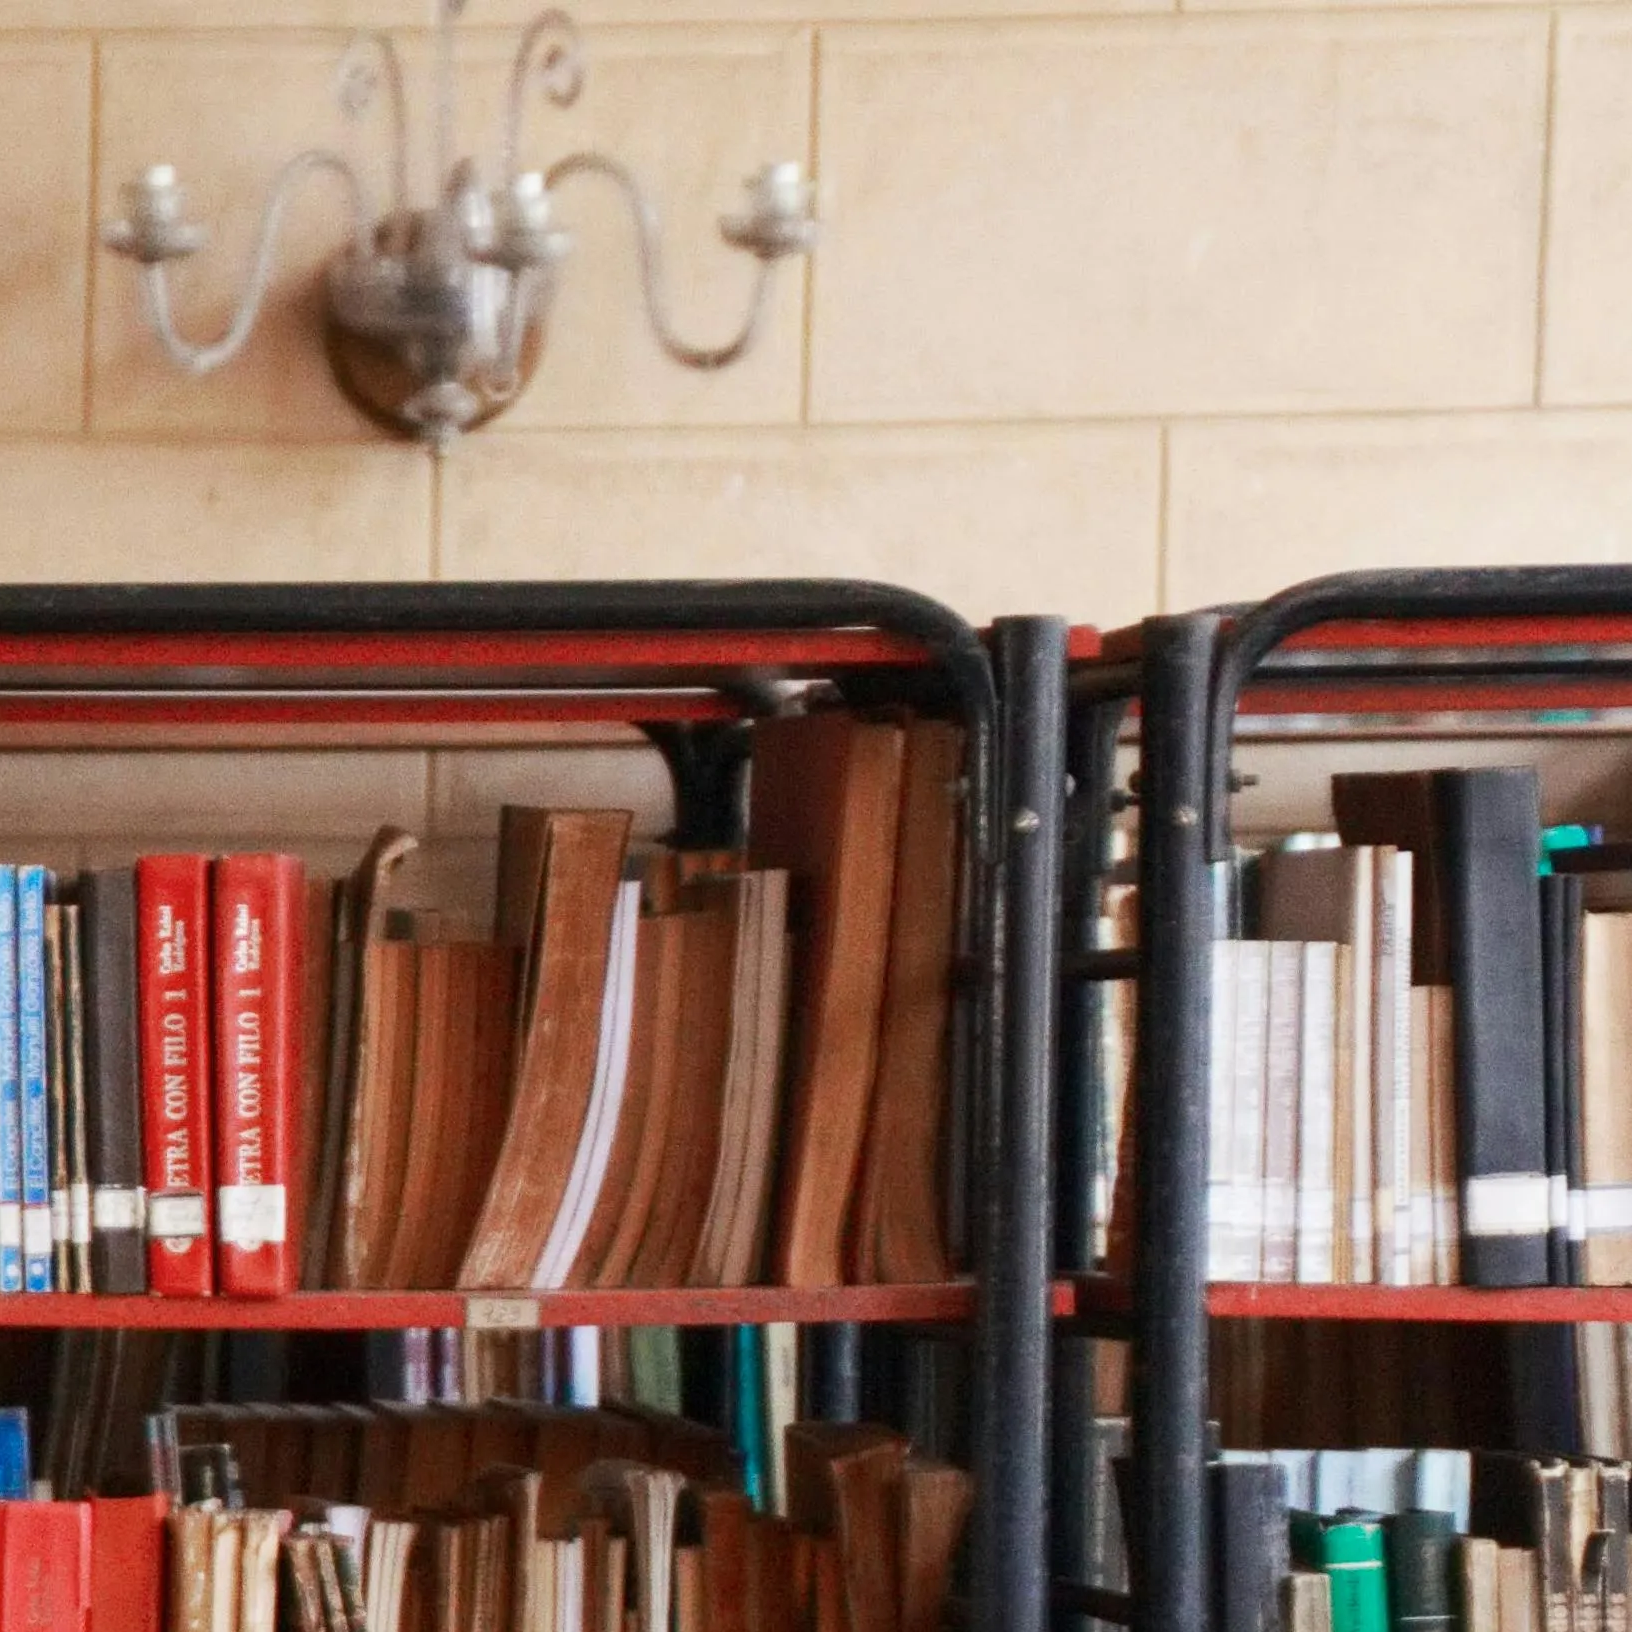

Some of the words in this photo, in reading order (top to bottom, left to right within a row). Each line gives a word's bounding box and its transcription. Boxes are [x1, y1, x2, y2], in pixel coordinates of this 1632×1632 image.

[157, 904, 173, 938] Rafael
[233, 904, 249, 939] Rafael
[158, 941, 173, 975] Carlos
[234, 940, 249, 975] Carlos
[163, 988, 188, 1001] 1
[237, 988, 262, 1000] 1
[0, 1019, 16, 1081] Manuel
[25, 1015, 42, 1079] Manuel
[161, 1012, 187, 1067] FILO
[237, 1010, 262, 1066] FILO
[162, 1073, 188, 1121] CON
[237, 1071, 262, 1119] CON
[164, 1127, 189, 1188] ETRA
[237, 1126, 263, 1186] ETRA
